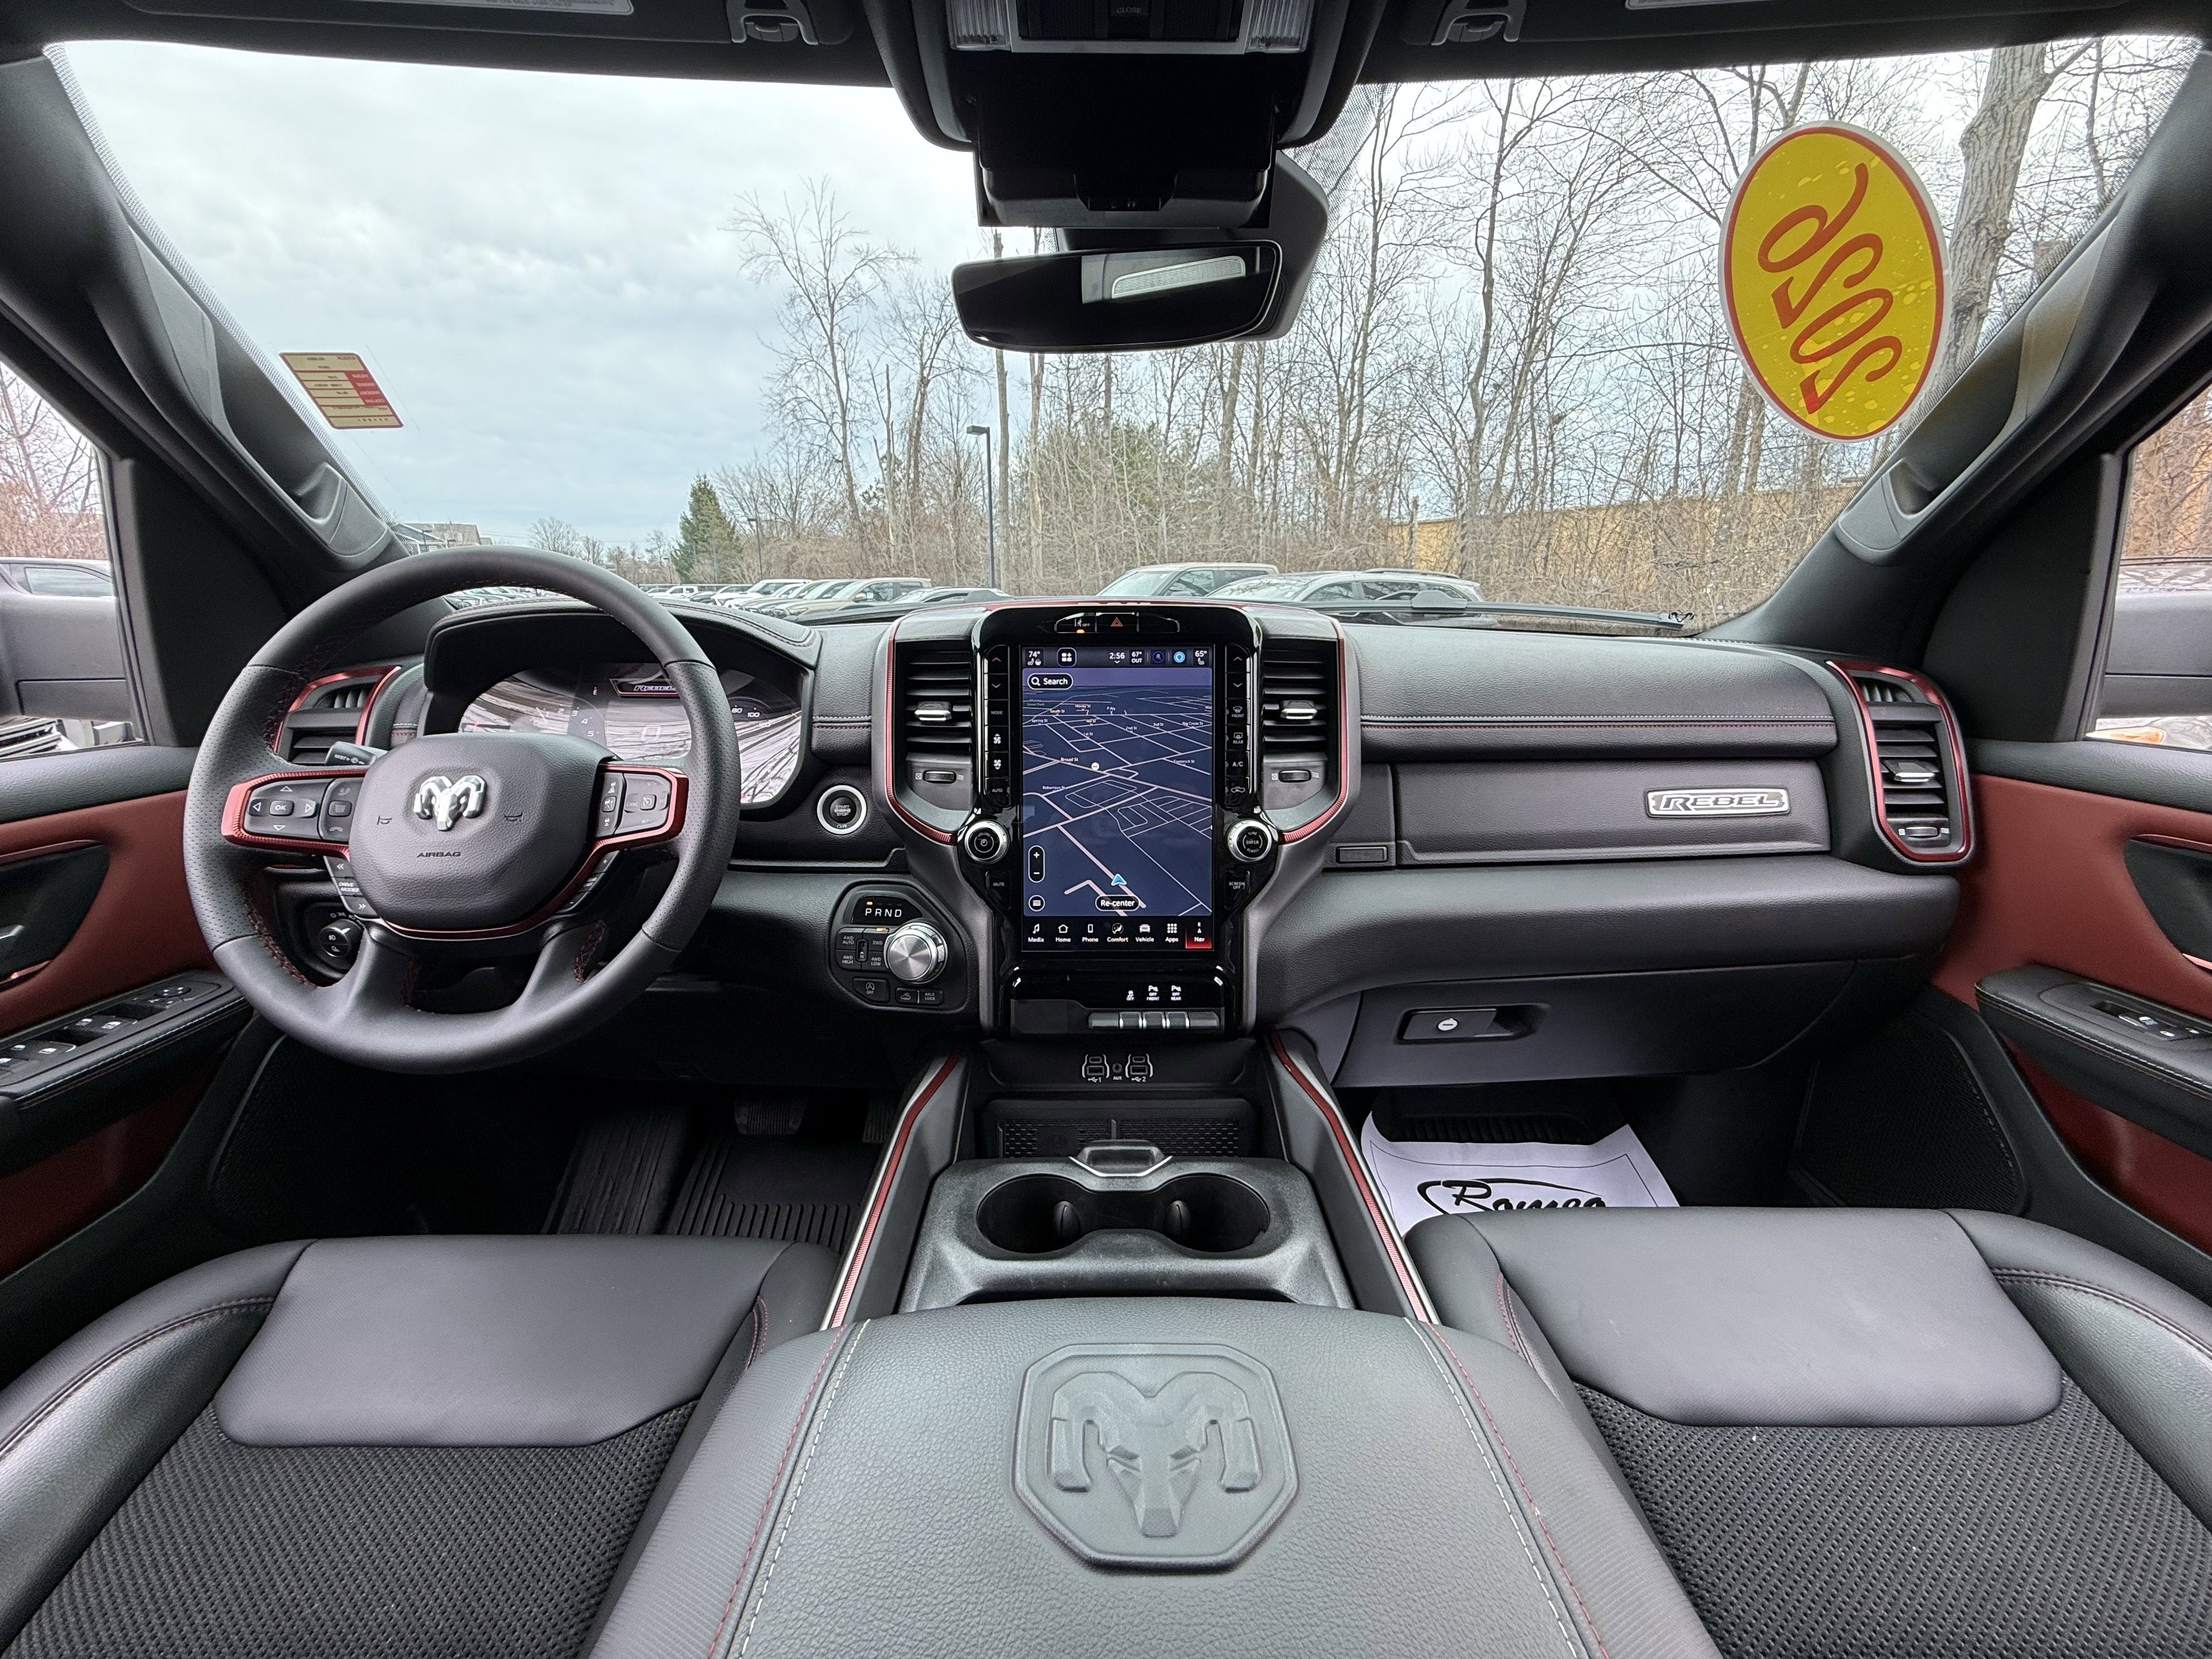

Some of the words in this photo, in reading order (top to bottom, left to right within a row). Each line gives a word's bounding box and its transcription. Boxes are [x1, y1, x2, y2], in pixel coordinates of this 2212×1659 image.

[1043, 678, 1068, 686] Search
[1659, 794, 1779, 811] REBEL
[1100, 899, 1136, 907] Re-center
